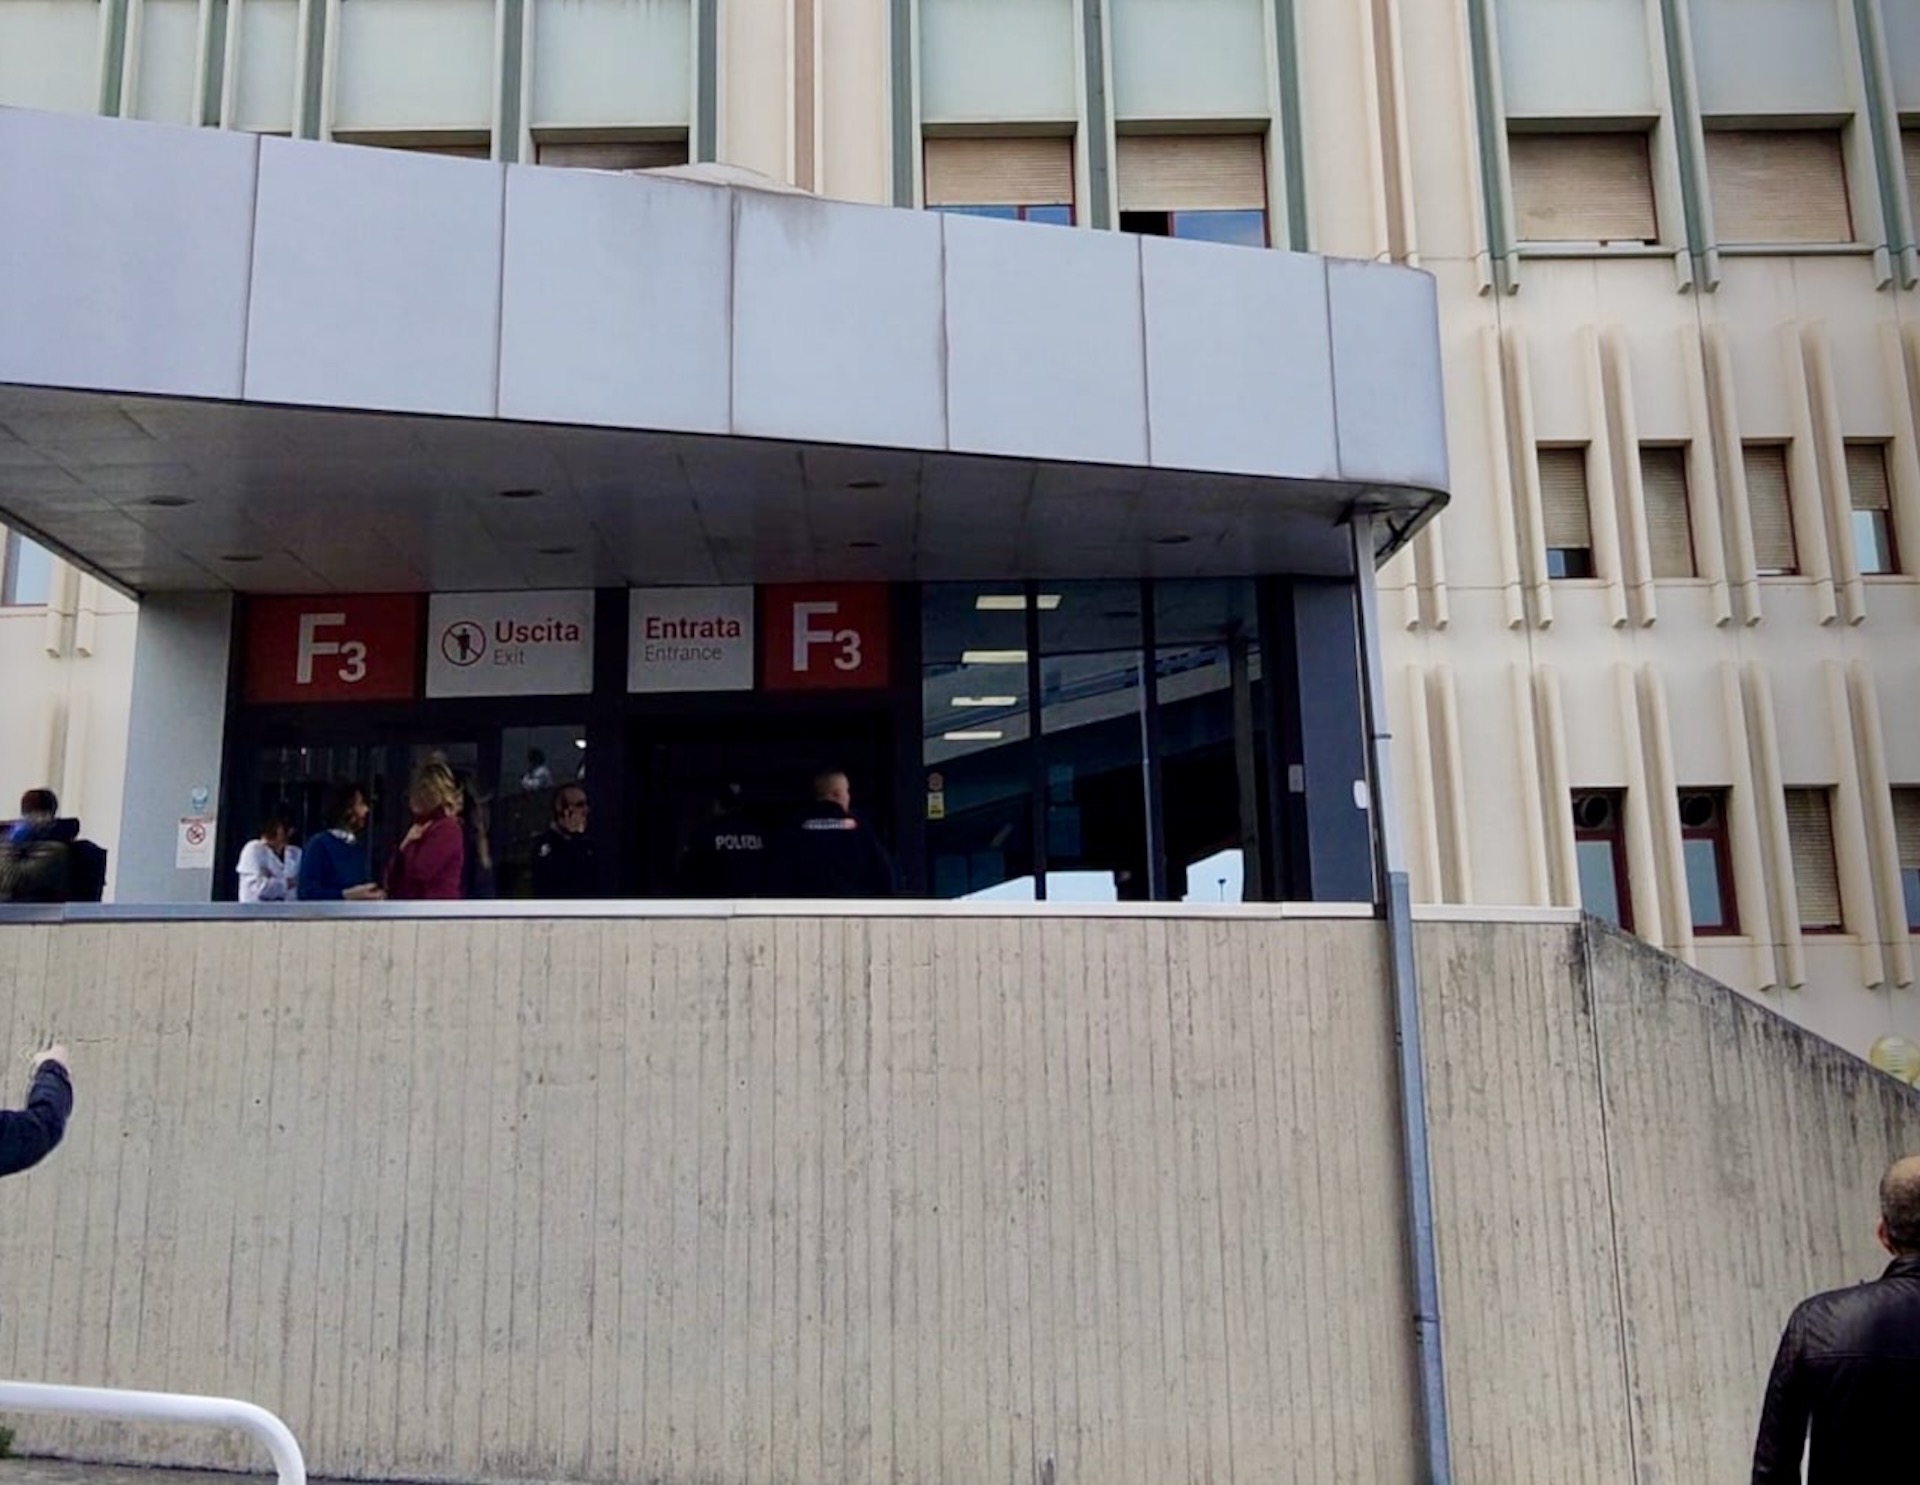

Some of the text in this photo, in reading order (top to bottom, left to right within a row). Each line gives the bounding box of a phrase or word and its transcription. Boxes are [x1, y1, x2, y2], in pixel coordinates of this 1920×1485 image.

[495, 618, 580, 644] Uscita
[645, 617, 741, 640] Entrata
[792, 601, 863, 671] F3
[296, 613, 368, 684] F3
[494, 647, 526, 665] Exit
[645, 644, 723, 662] Entrance
